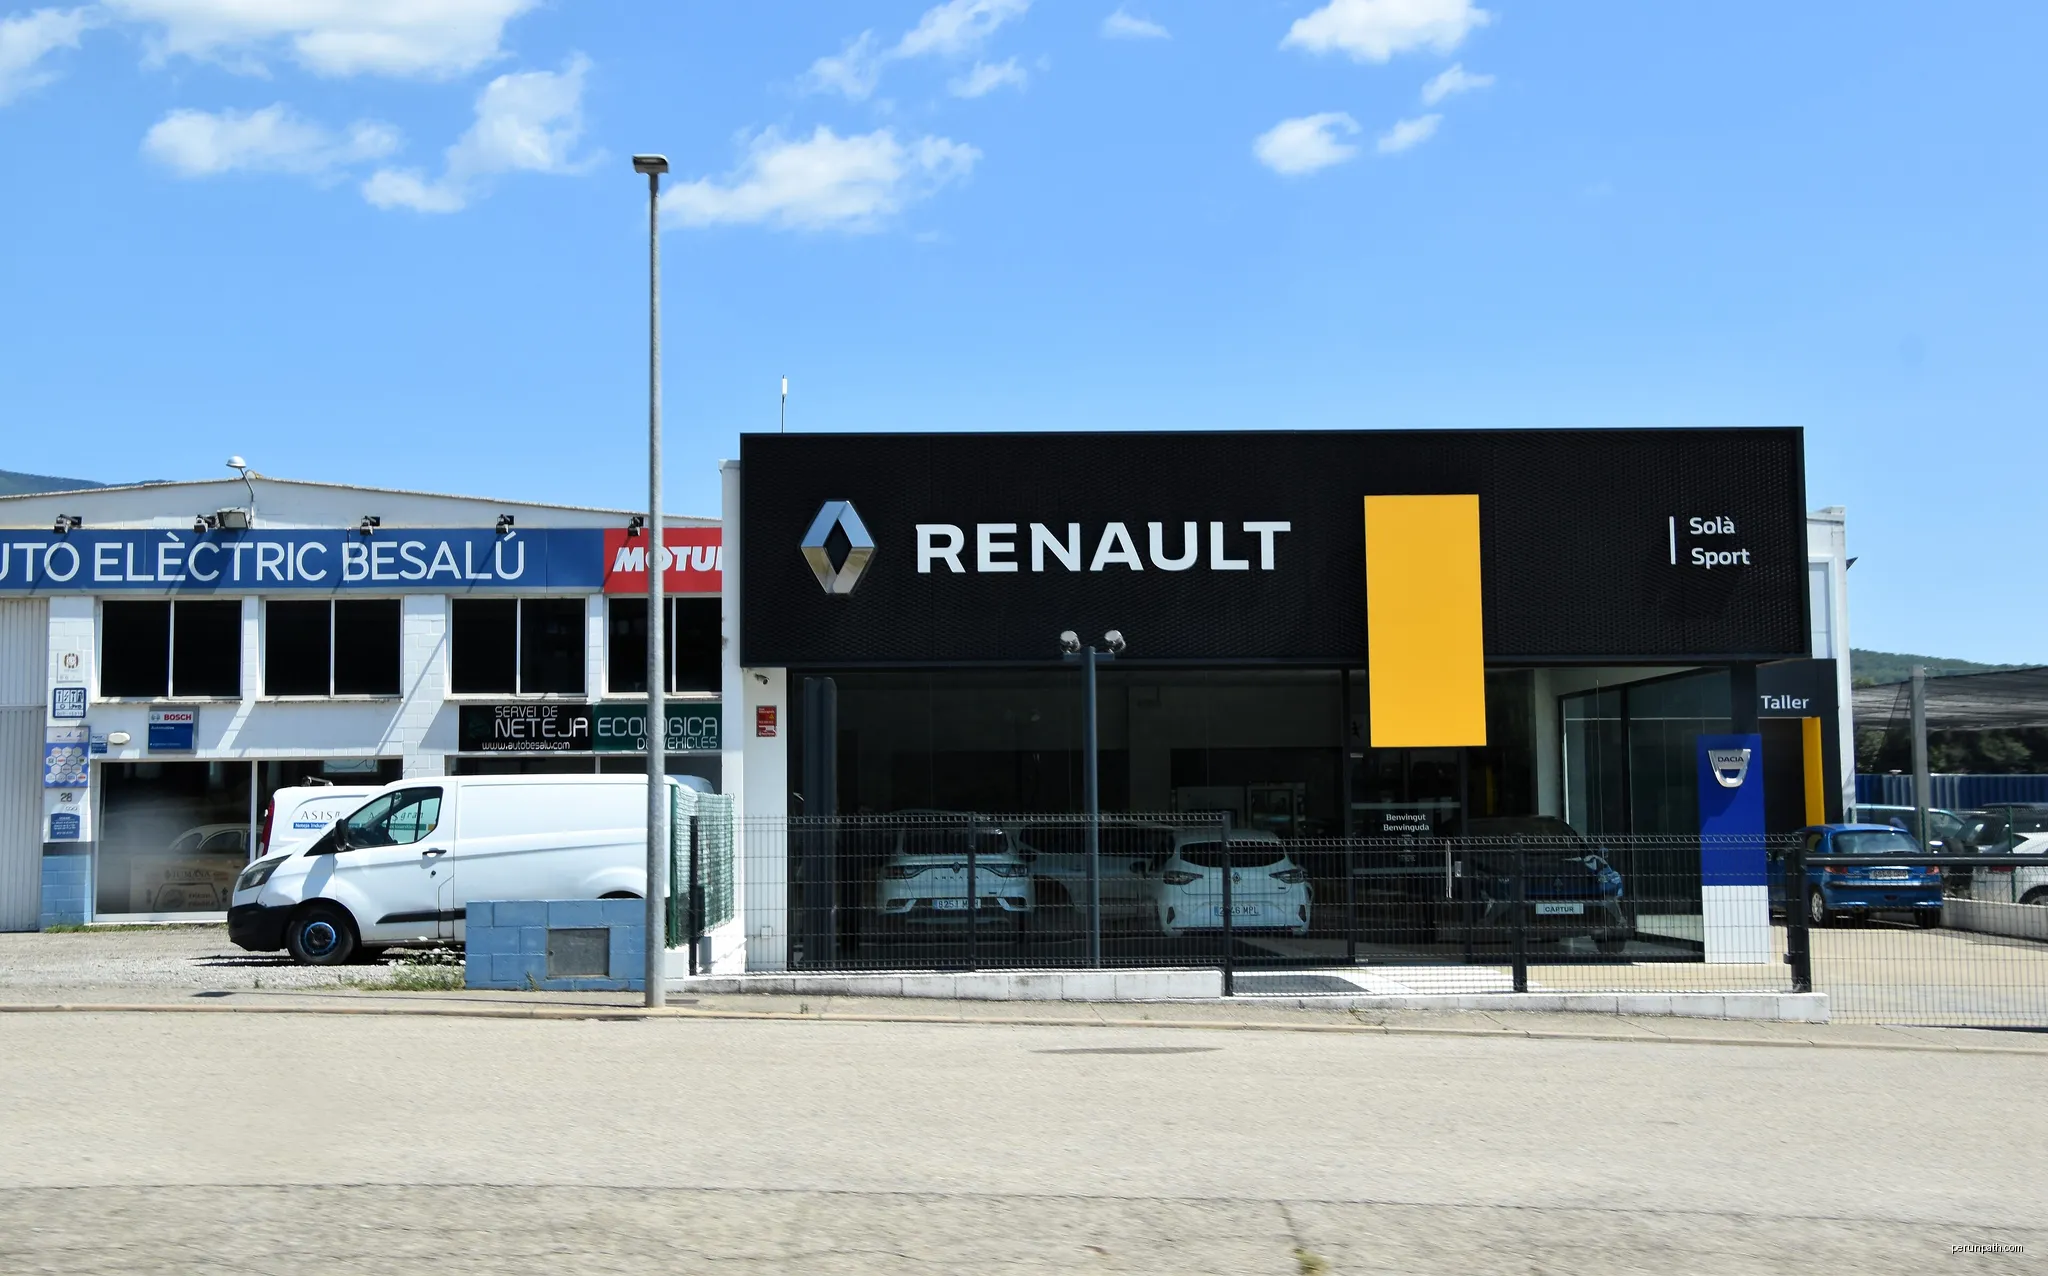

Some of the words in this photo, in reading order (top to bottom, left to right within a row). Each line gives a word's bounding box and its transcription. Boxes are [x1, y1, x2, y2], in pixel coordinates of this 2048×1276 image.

[1689, 516, 1735, 535] Solà
[915, 521, 1291, 574] RENAULT
[94, 531, 328, 582] ELÈCTRIC
[343, 530, 525, 581] BESALÚ
[1691, 547, 1751, 569] Sport
[1760, 695, 1810, 710] Taller
[163, 713, 192, 721] BOSCH
[494, 705, 537, 718] SERVEI
[542, 705, 558, 718] DE
[494, 717, 589, 738] NETEJA
[597, 716, 718, 737] ECOGICA
[636, 737, 649, 750] D
[60, 792, 73, 803] 28
[1385, 813, 1426, 823] Benvingut
[1382, 823, 1430, 833] Benvinguda
